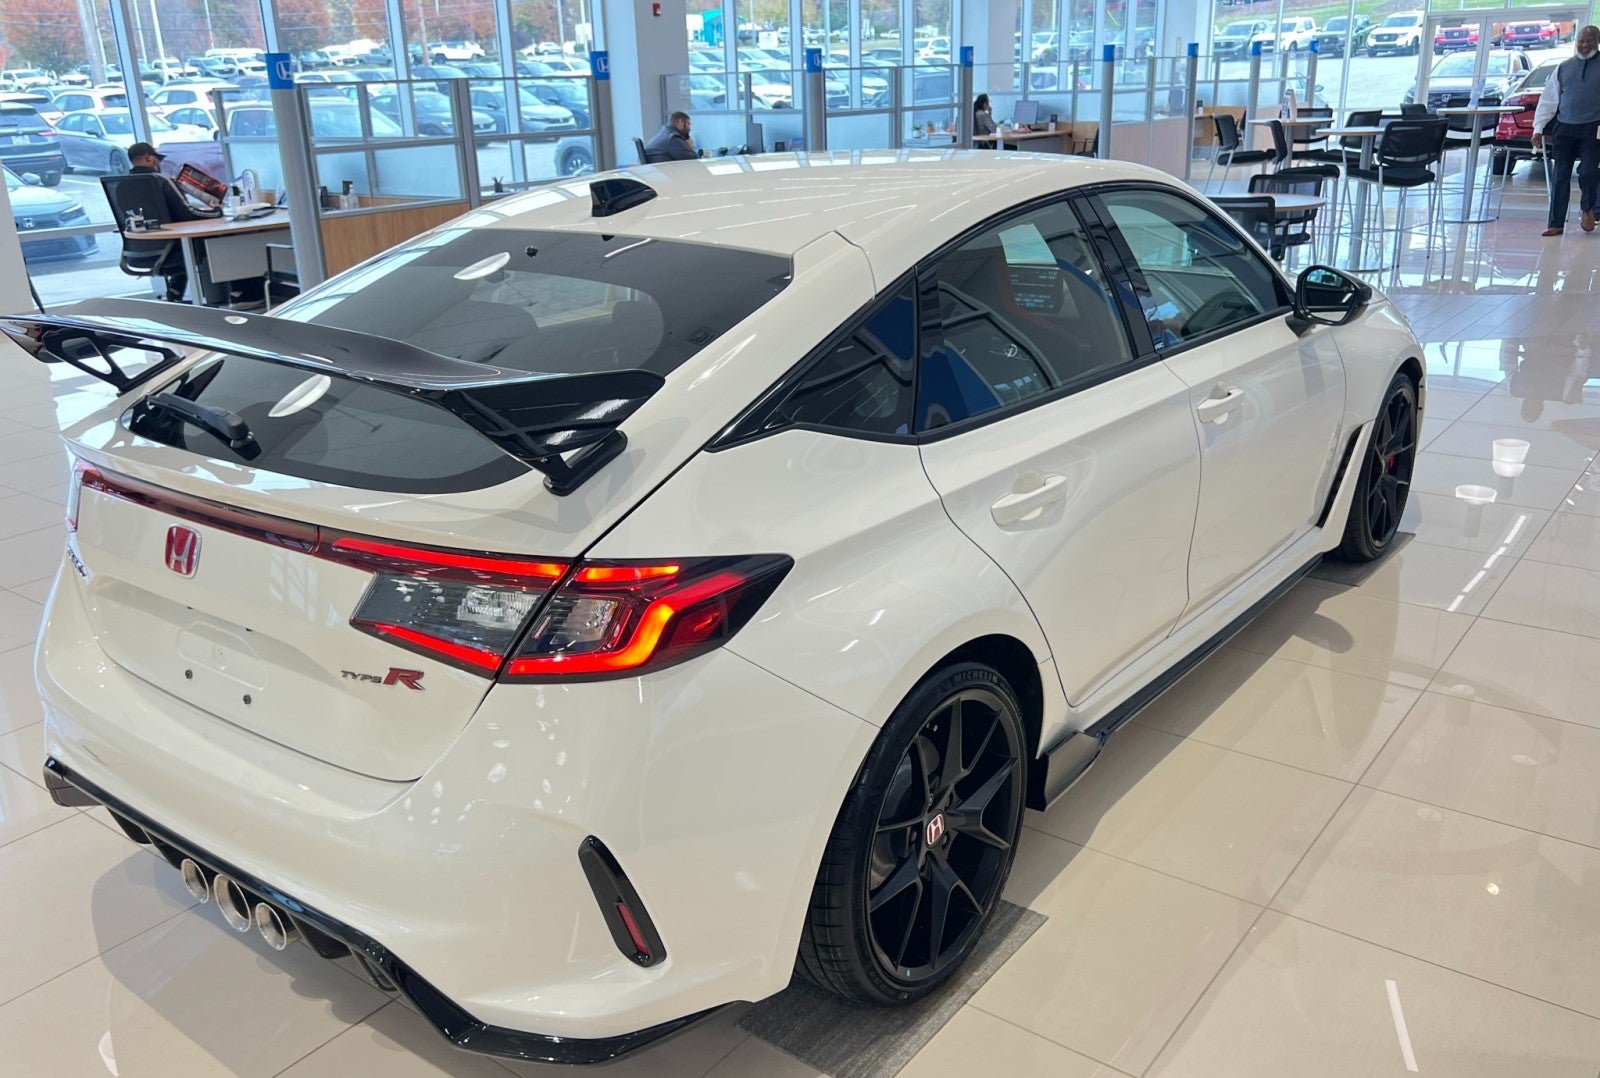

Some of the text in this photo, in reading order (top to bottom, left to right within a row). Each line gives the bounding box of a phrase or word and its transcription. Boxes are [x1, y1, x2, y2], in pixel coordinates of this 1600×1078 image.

[341, 667, 425, 691] TYPE R
[953, 670, 998, 684] MICHELIN
